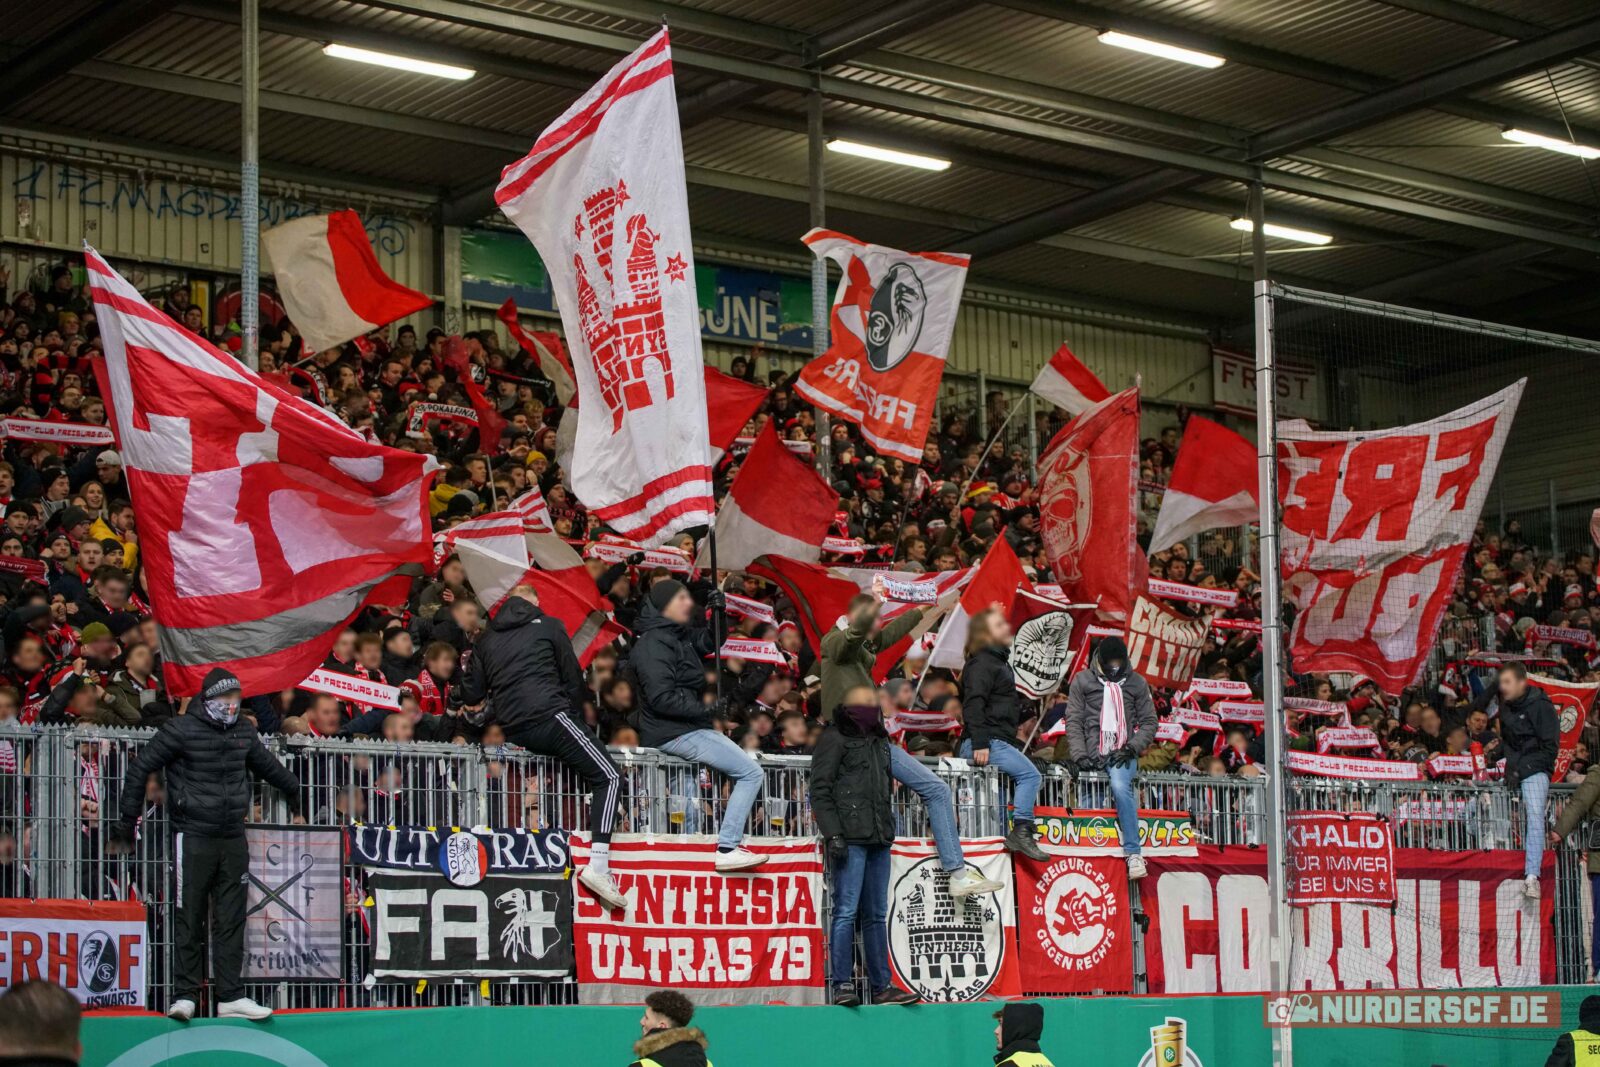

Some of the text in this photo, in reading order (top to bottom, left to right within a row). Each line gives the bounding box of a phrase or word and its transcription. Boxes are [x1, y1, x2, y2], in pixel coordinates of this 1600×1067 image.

[1222, 361, 1309, 400] FRST
[1287, 824, 1385, 849] KHALID
[1326, 855, 1387, 872] IMMER
[1299, 876, 1375, 893] BEI UNS
[587, 933, 812, 983] ULTRAS 79
[909, 940, 985, 954] SYNTHESIA
[1075, 928, 1116, 971] RECHTS
